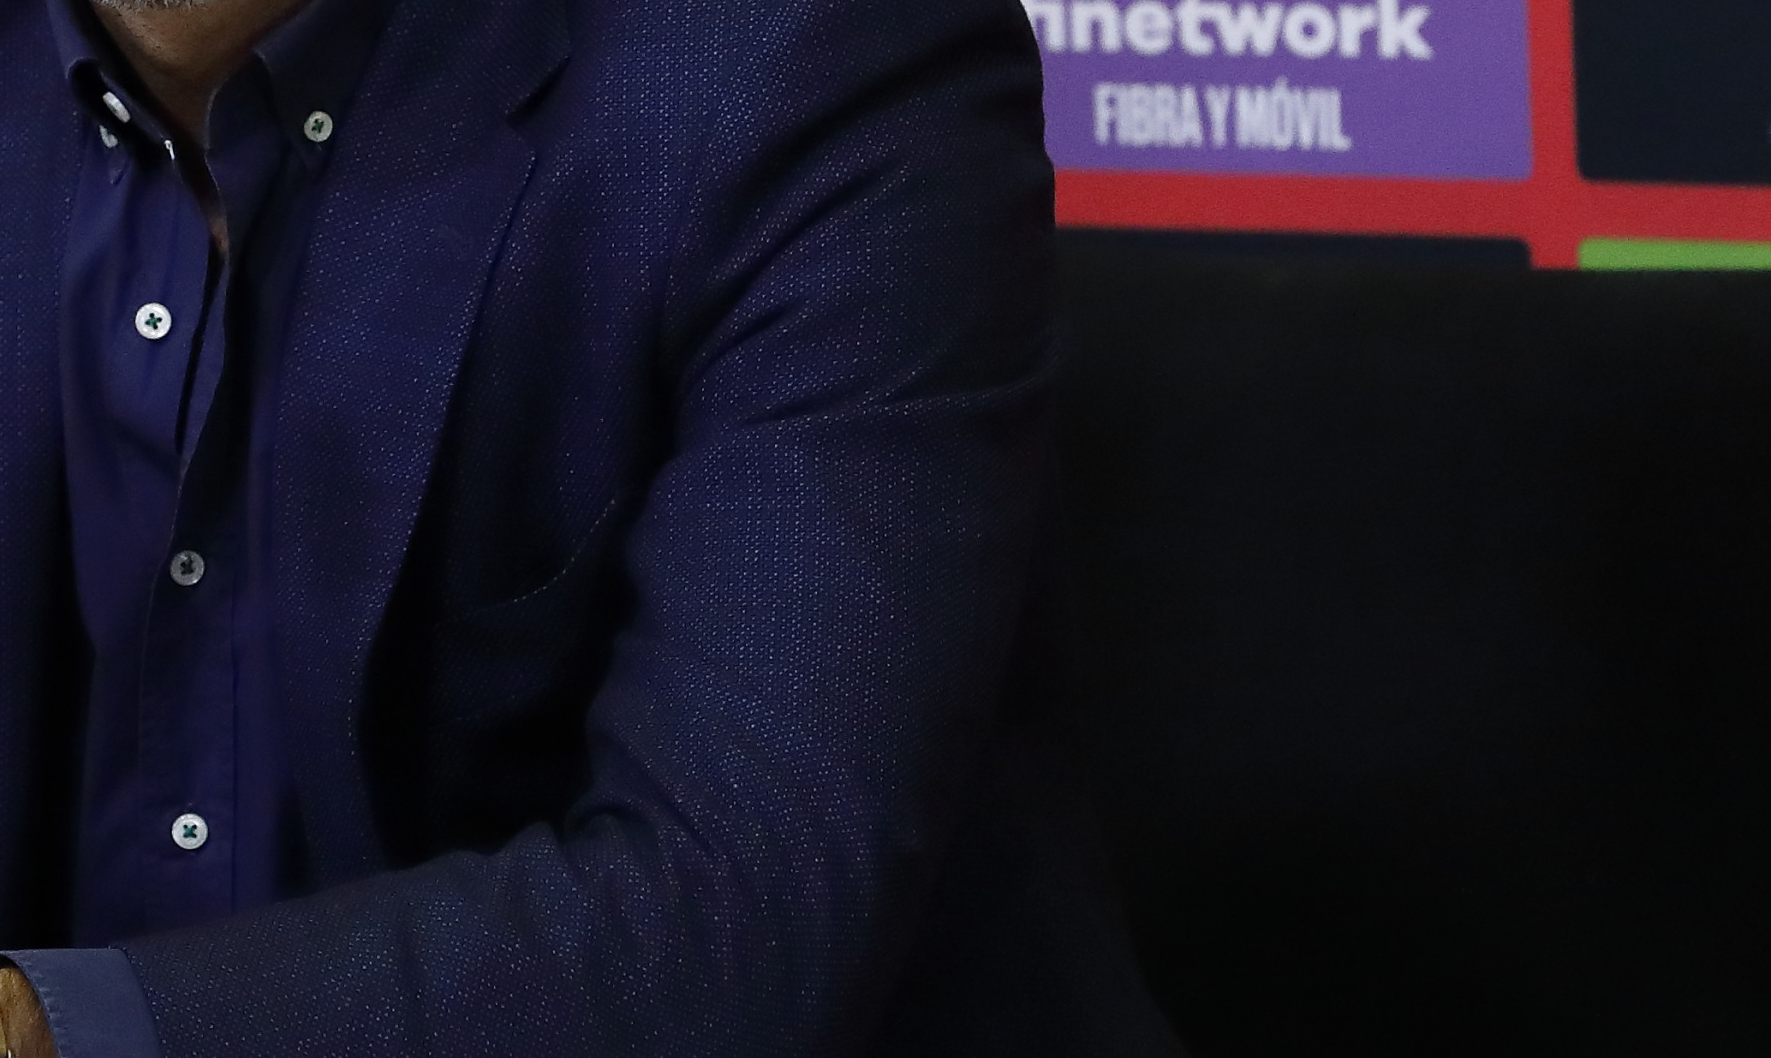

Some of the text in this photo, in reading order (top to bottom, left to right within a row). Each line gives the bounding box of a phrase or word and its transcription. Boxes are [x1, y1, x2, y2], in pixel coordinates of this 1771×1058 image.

[1093, 76, 1352, 152] FIBRA Y MÓVIL
